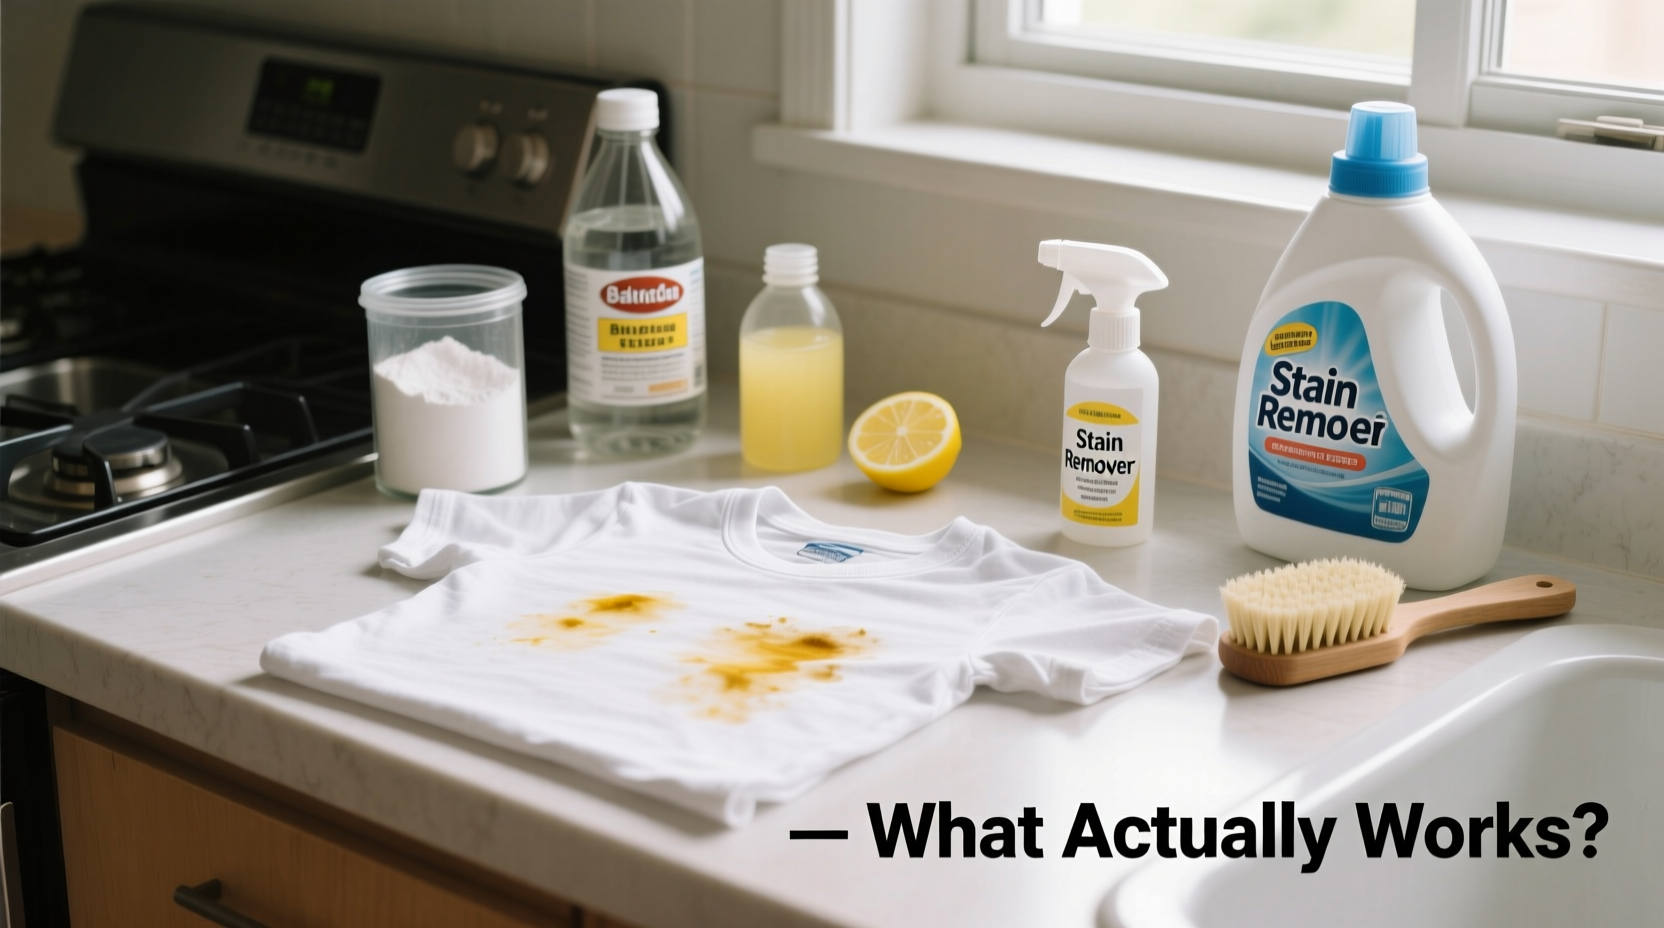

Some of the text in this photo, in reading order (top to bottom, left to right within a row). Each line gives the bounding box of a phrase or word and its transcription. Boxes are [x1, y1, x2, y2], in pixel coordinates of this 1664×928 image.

[1270, 360, 1358, 409] Stain
[1076, 428, 1123, 452] Stain
[1065, 448, 1136, 476] Remover
